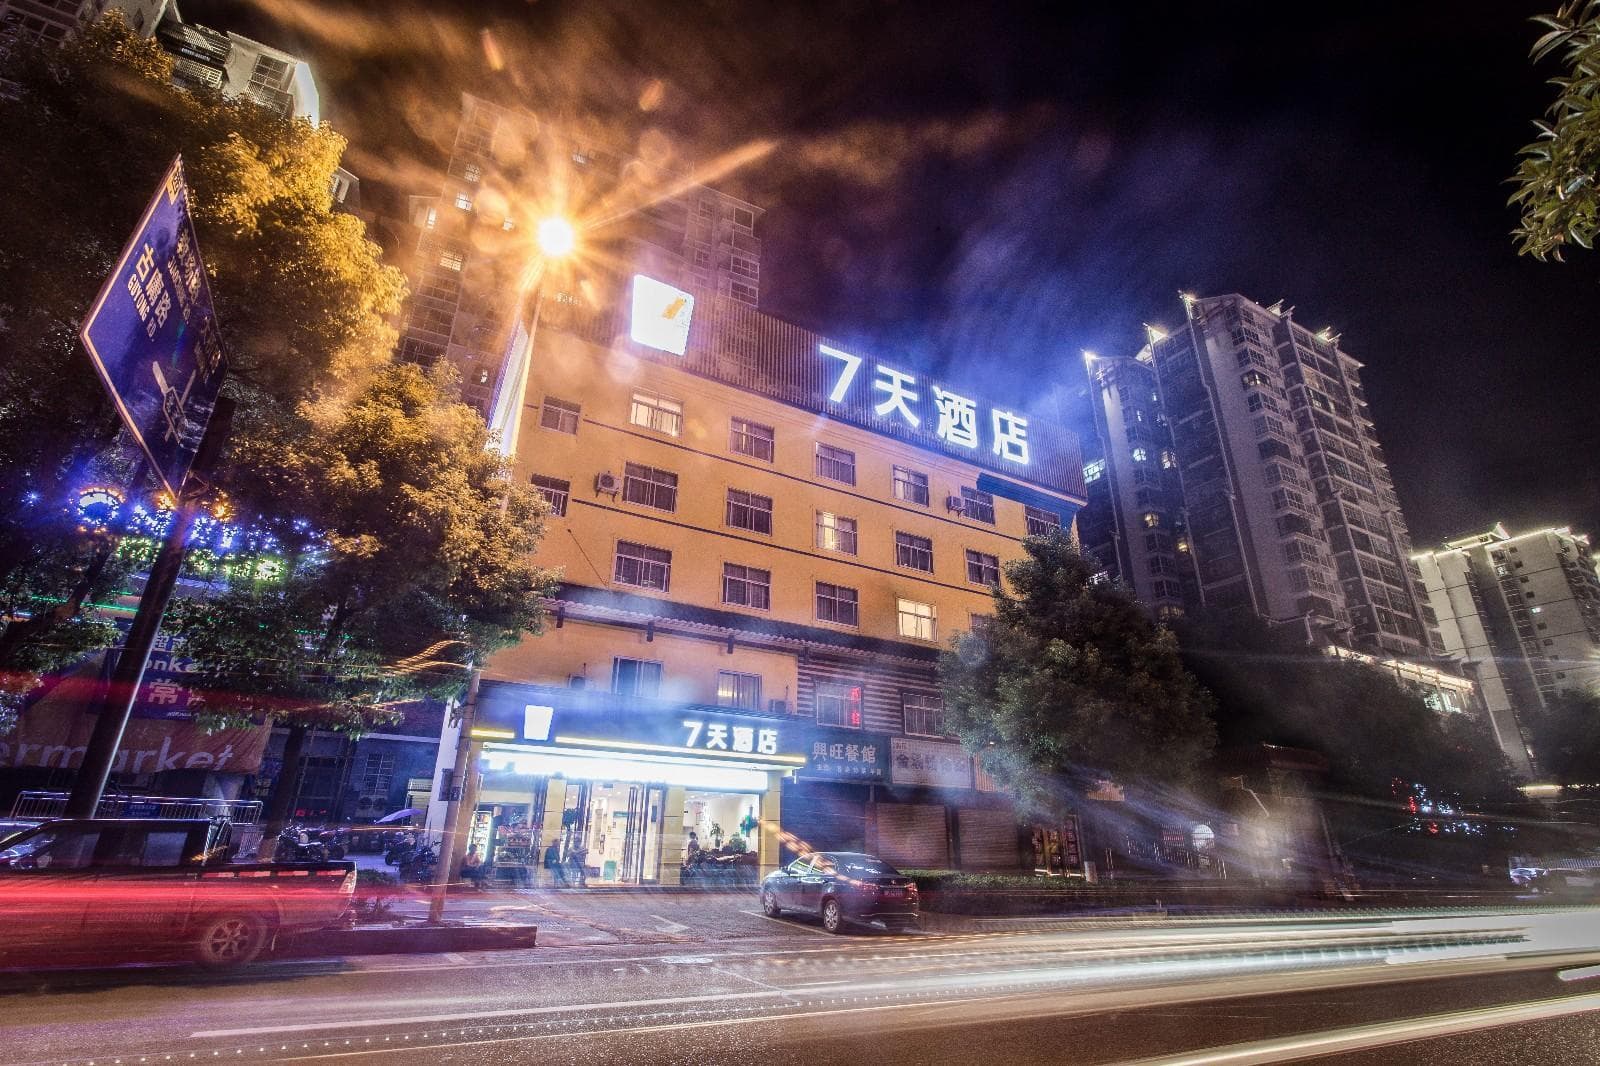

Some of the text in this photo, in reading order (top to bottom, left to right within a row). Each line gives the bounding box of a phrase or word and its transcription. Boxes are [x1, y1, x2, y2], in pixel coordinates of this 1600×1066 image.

[128, 274, 150, 322] GUYONG
[820, 344, 1029, 465] 7天酒店
[683, 721, 778, 755] 7天酒店
